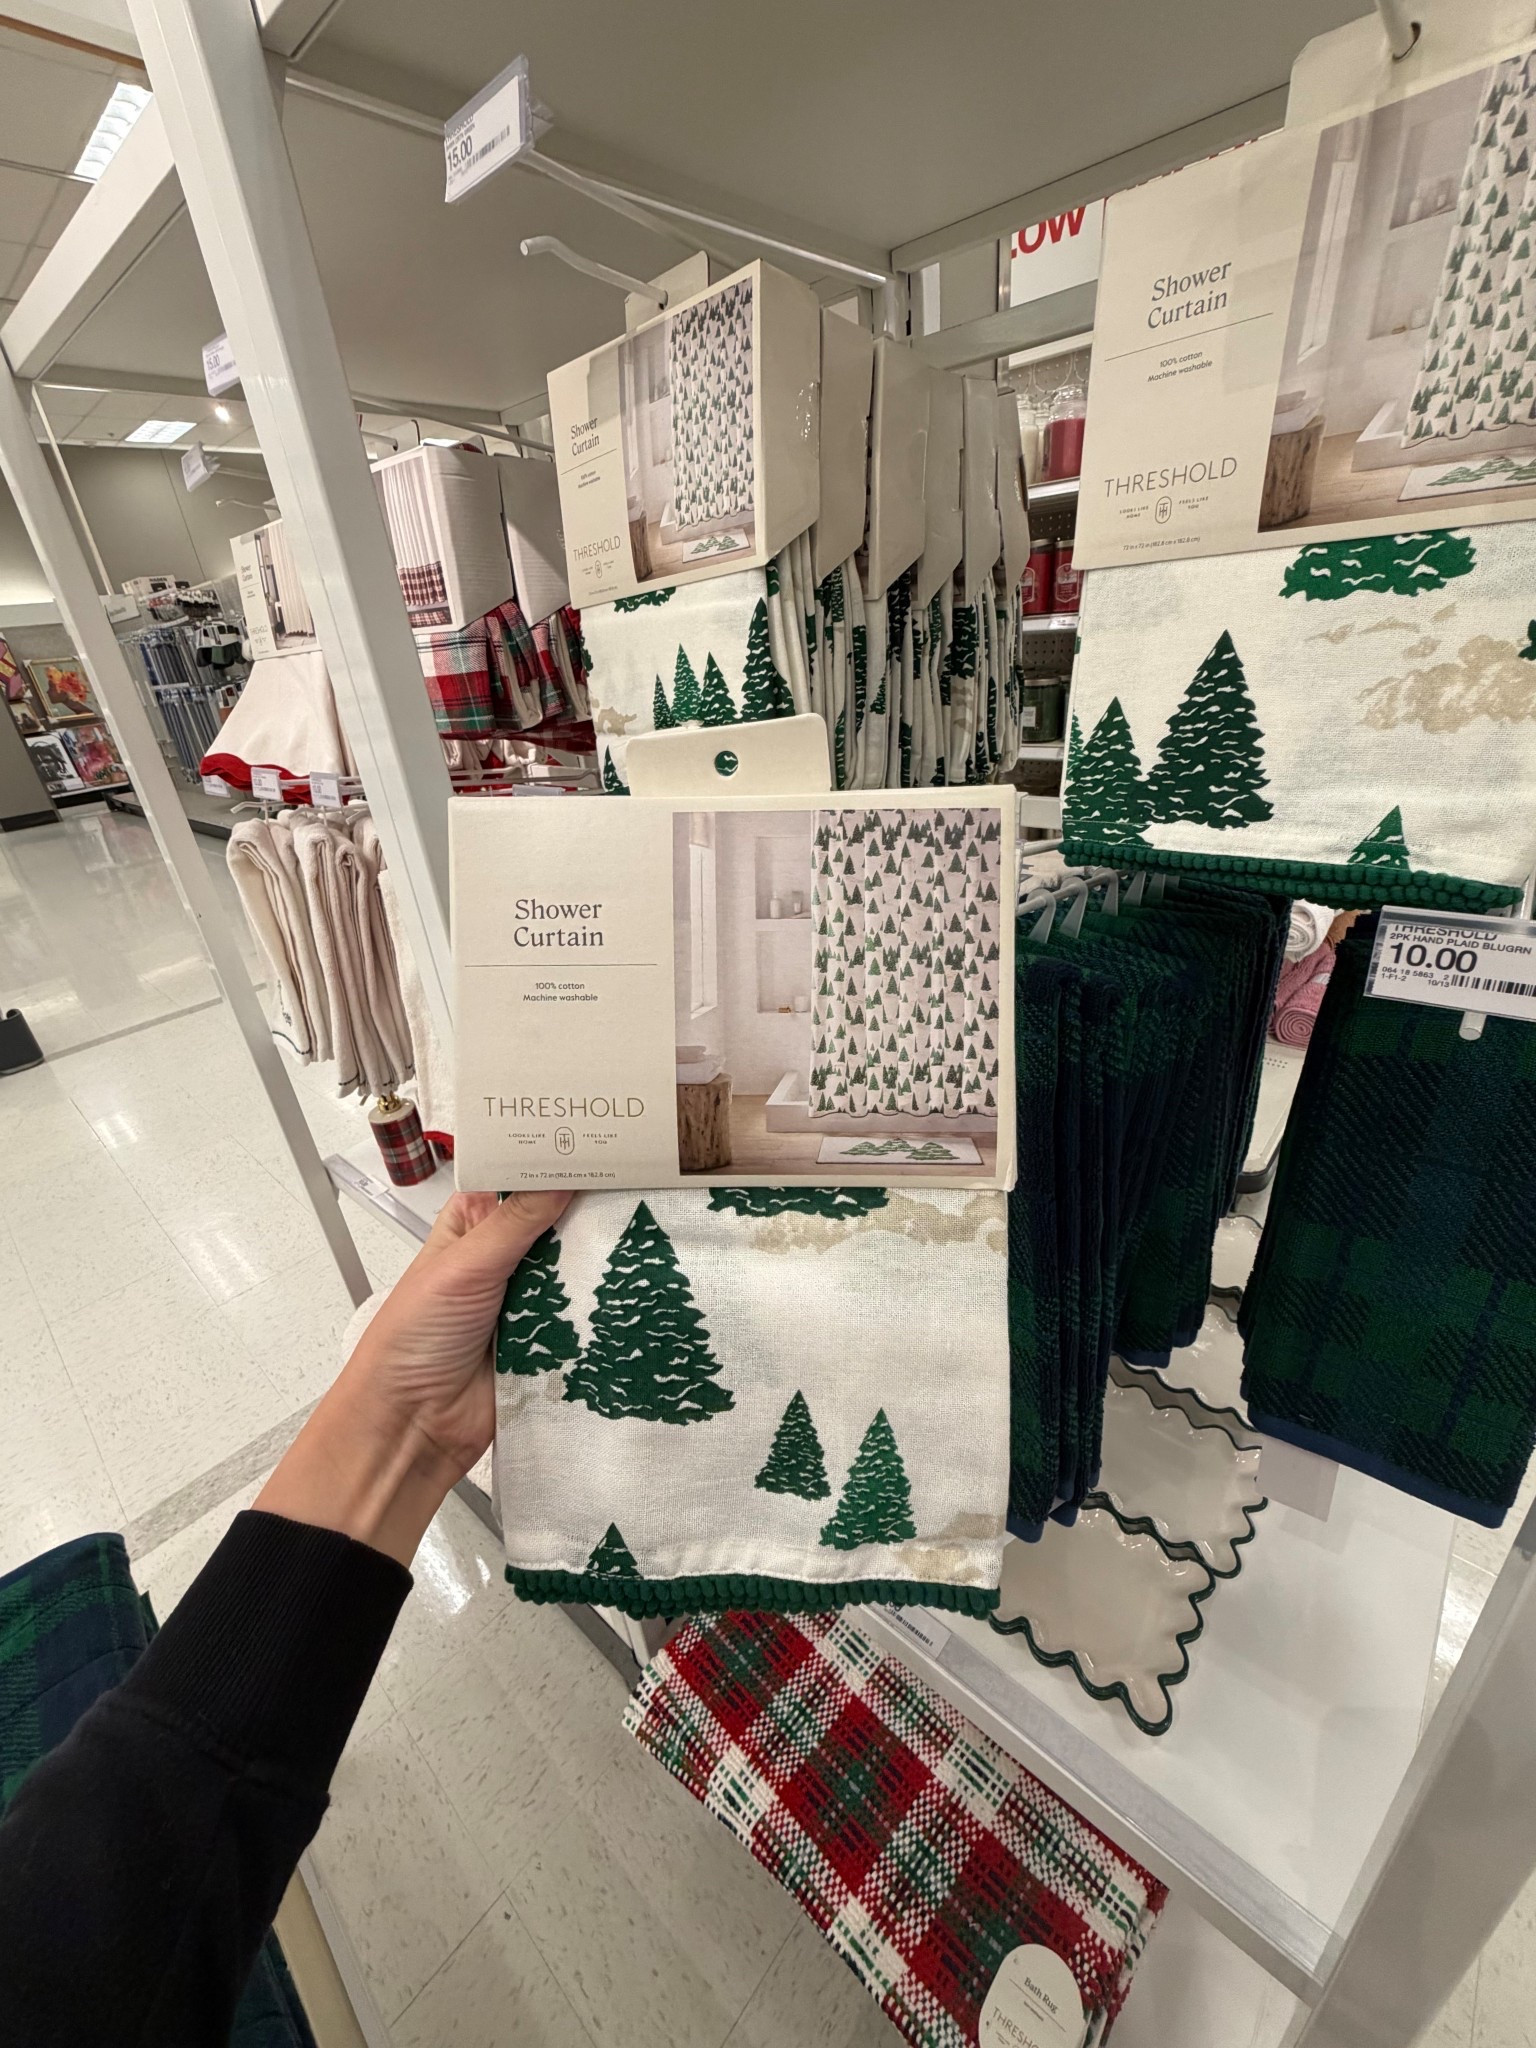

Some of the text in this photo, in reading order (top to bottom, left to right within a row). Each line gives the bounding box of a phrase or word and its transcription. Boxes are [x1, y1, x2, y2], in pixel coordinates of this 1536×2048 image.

[448, 135, 472, 171] 15.00
[1011, 205, 1086, 259] OW
[1151, 262, 1232, 302] Shower
[1147, 290, 1228, 329] Curtain
[1147, 360, 1213, 382] Machine washable
[1160, 351, 1203, 368] 100% cotton
[570, 417, 598, 440] Shower
[571, 433, 600, 456] Curtain
[1104, 457, 1238, 498] THRESHOLD
[573, 535, 621, 561] THRESHOLD
[514, 898, 603, 920] Shower
[513, 926, 604, 947] Curtain
[1389, 932, 1532, 955] 2PK HAND PLAID BLUGRN
[1390, 942, 1478, 973] 10.00
[1381, 973, 1450, 988] 1-F1-2 10/13
[1400, 968, 1410, 976] 18
[1412, 970, 1434, 979] 5863
[535, 981, 585, 990] 100% cotton
[523, 993, 598, 1002] Machine washable
[483, 1096, 645, 1118] THRESHOLD
[1023, 1976, 1042, 1999] Bath
[1042, 1993, 1059, 2014] Rug
